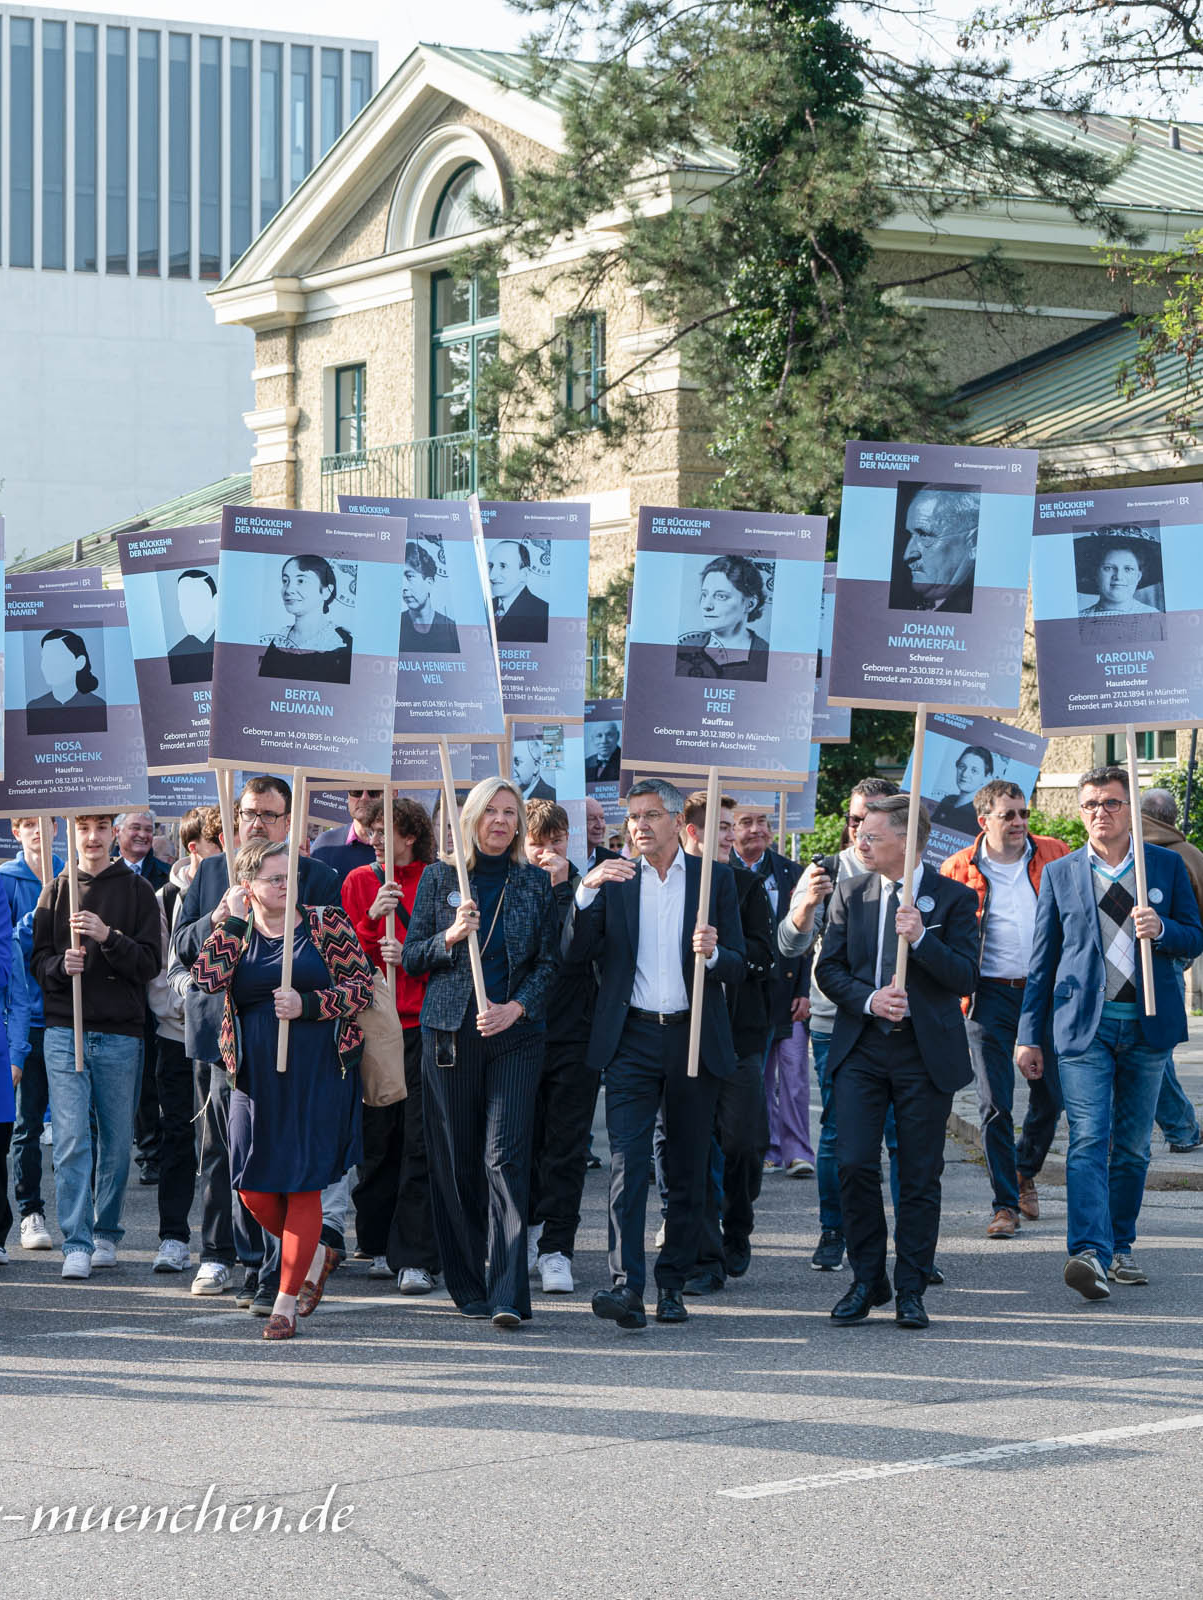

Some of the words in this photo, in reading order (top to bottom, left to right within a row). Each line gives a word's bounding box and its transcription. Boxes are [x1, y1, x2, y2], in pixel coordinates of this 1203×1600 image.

[860, 452, 874, 460] DIE
[875, 452, 919, 463] RÜCKKEHR
[860, 461, 876, 469] DER
[878, 462, 910, 471] NAMEN
[1053, 500, 1094, 510] RÜCKKEHR
[1057, 509, 1086, 517] NAMEN
[235, 517, 248, 525] DIE
[250, 517, 292, 528] RÜCKKEHR
[652, 517, 666, 526] DIE
[667, 517, 710, 528] RÜCKKEHR
[235, 525, 250, 534] DER
[252, 527, 283, 536] NAMEN
[652, 526, 668, 534] DER
[670, 527, 701, 536] NAMEN
[903, 624, 954, 636] JOHANN
[888, 636, 966, 651] NIMMERFALL
[910, 654, 944, 662] Schreiner
[1096, 650, 1154, 664] KAROLINA
[398, 661, 421, 671] AULA
[422, 661, 466, 672] HENRIETTE
[862, 664, 893, 672] Geboren
[954, 669, 989, 678] München
[1105, 664, 1147, 676] STEIDLE
[422, 674, 443, 684] WEIL
[864, 674, 898, 683] Ermordet
[962, 680, 986, 690] Pasing
[1106, 679, 1148, 687] Haustochter
[285, 688, 320, 702] BERTA
[704, 688, 735, 700] LUISE
[1155, 688, 1187, 696] München
[270, 701, 333, 716] NEUMANN
[707, 702, 731, 713] FREI
[1068, 702, 1100, 711] Ermordet
[702, 718, 733, 726] Kauffrau
[243, 727, 272, 736] Geboren
[654, 727, 684, 735] Geboren
[746, 733, 780, 742] München
[55, 741, 82, 751] ROSA
[261, 738, 293, 748] Ermordet
[303, 743, 339, 752] Auschwitz
[676, 738, 709, 747] Ermordet
[35, 752, 102, 763] WEINSCHENK
